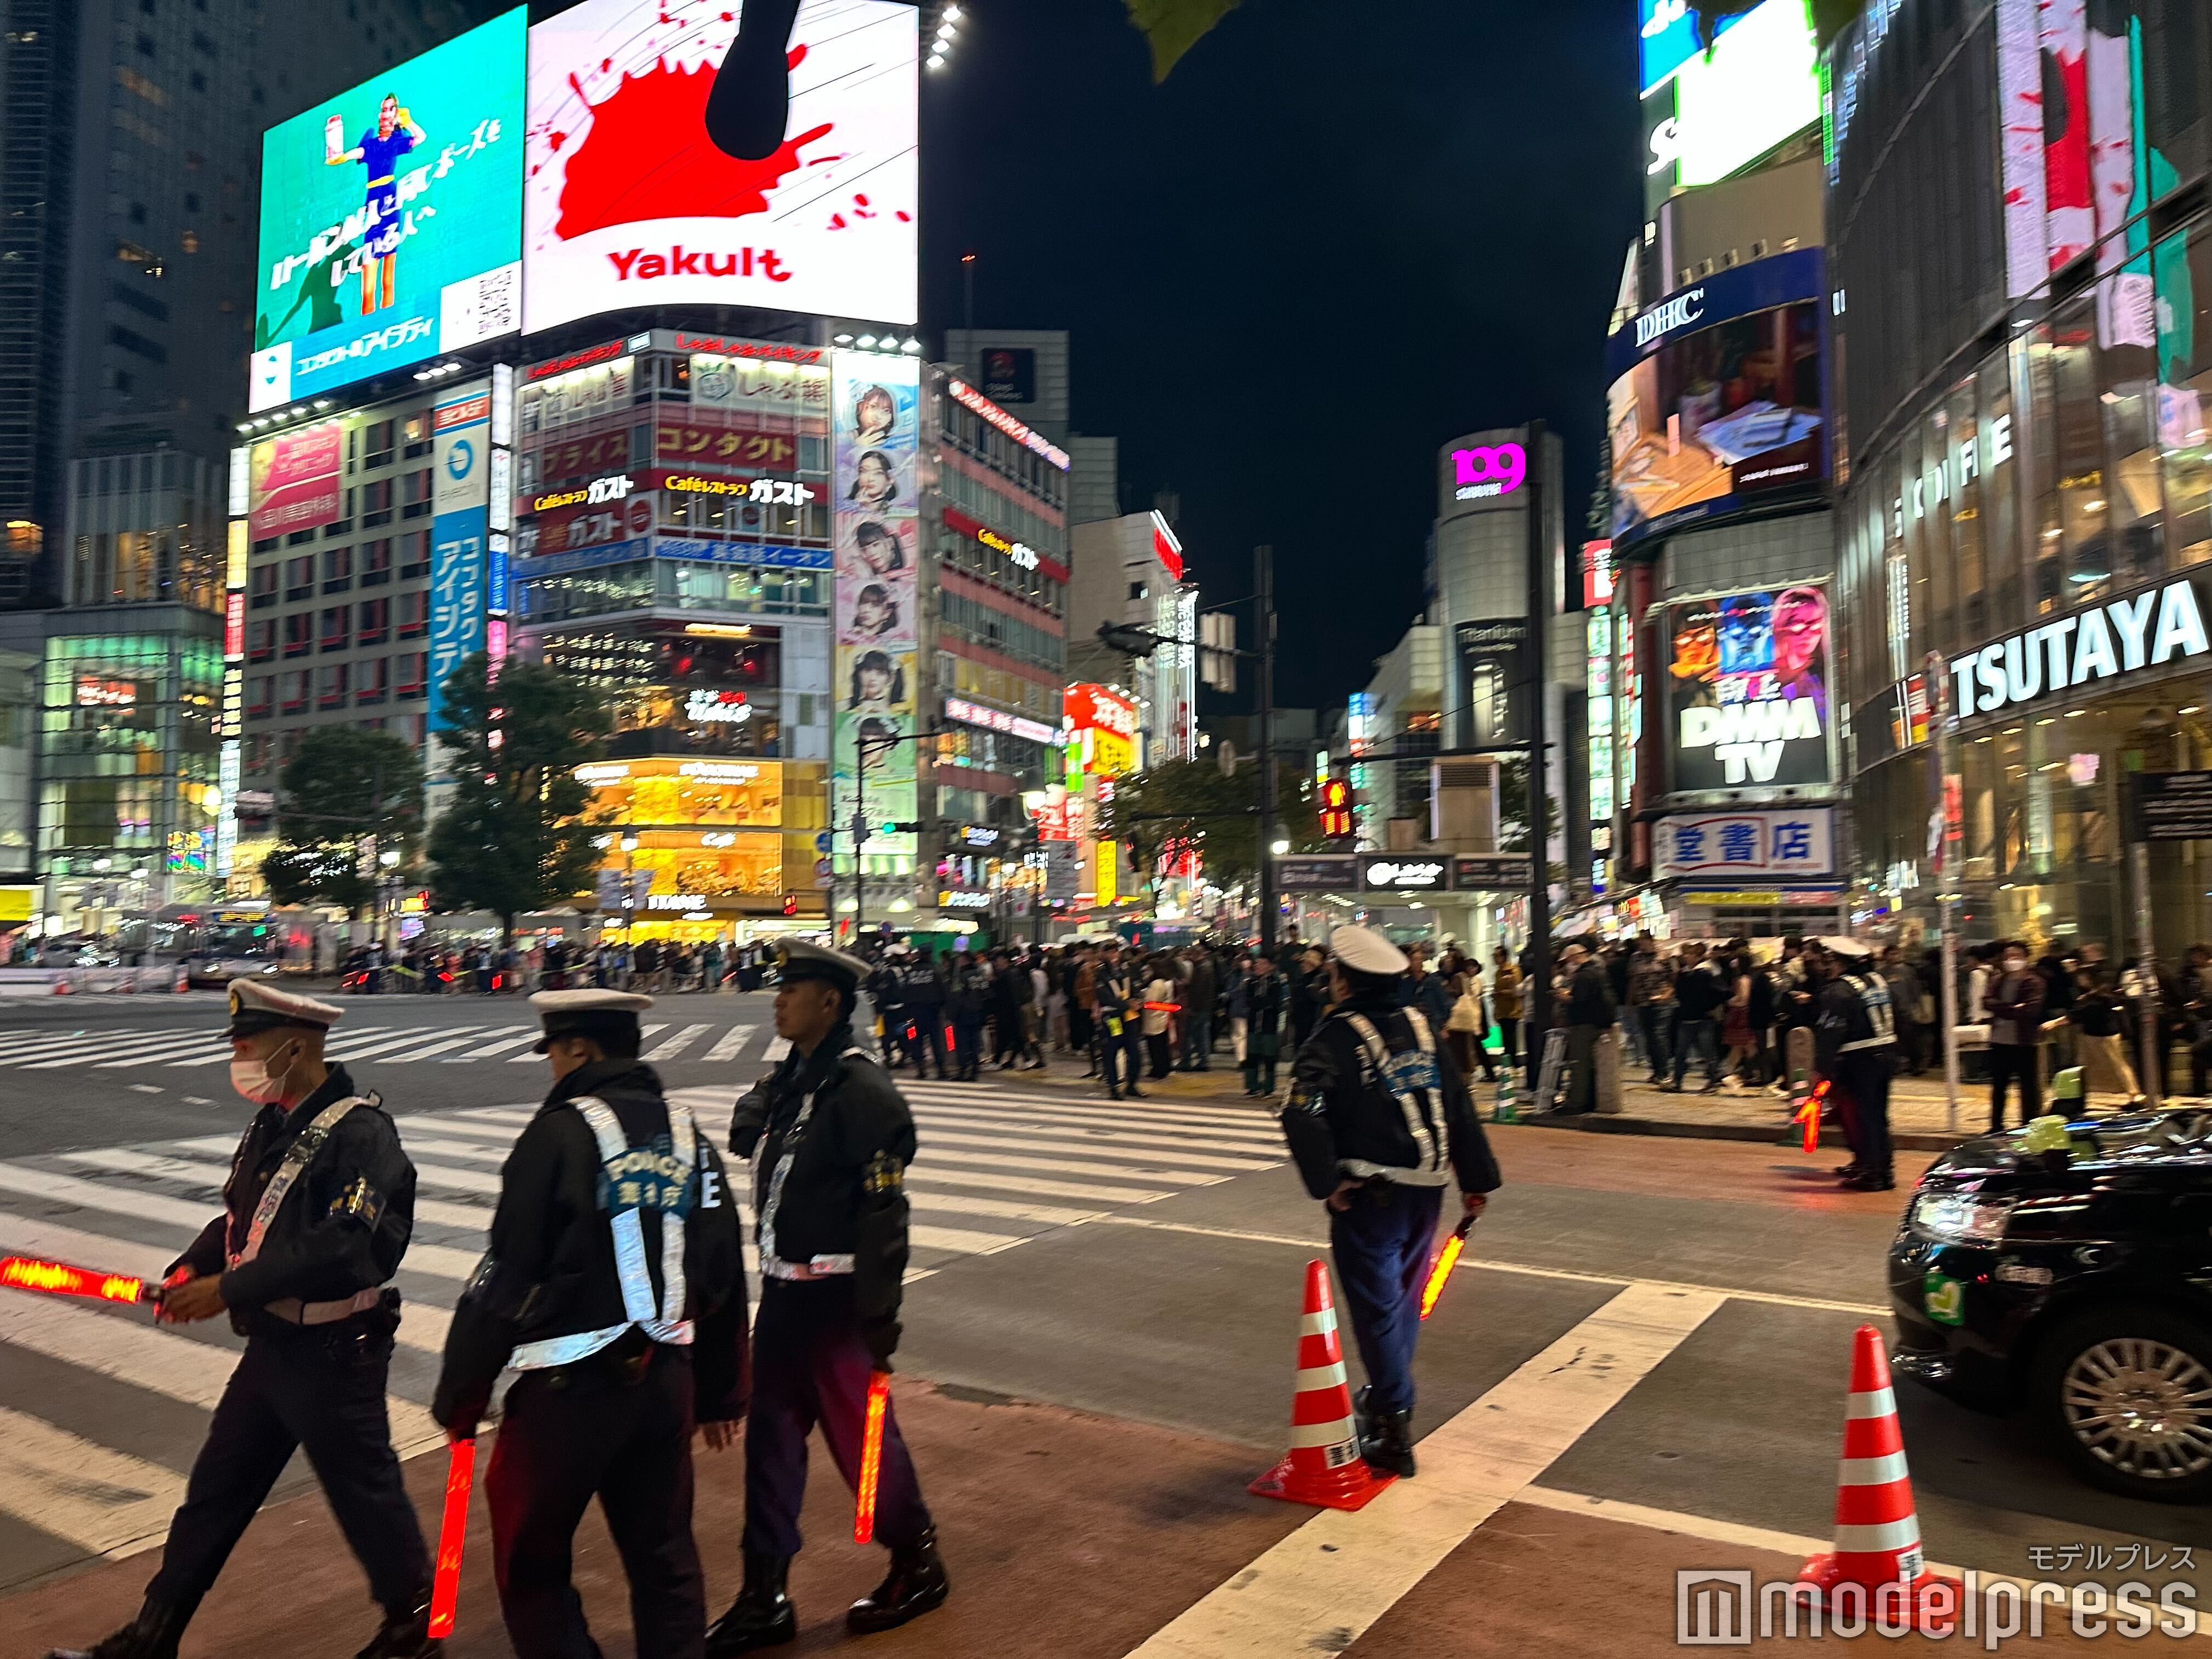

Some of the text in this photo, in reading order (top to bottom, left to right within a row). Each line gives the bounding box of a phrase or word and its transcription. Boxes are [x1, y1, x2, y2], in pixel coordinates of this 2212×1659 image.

[607, 245, 794, 282] Yakult
[1635, 287, 1703, 347] DHC
[658, 427, 794, 462] コンタクト
[1452, 442, 1526, 494] 109
[588, 475, 634, 505] ガスト
[749, 478, 815, 506] ガスト
[566, 511, 622, 548] ガスト
[1950, 579, 2208, 718] TSUTAYA
[1714, 741, 1785, 784] TV
[1675, 821, 1810, 861] 堂書店
[605, 1150, 693, 1186] POLICE
